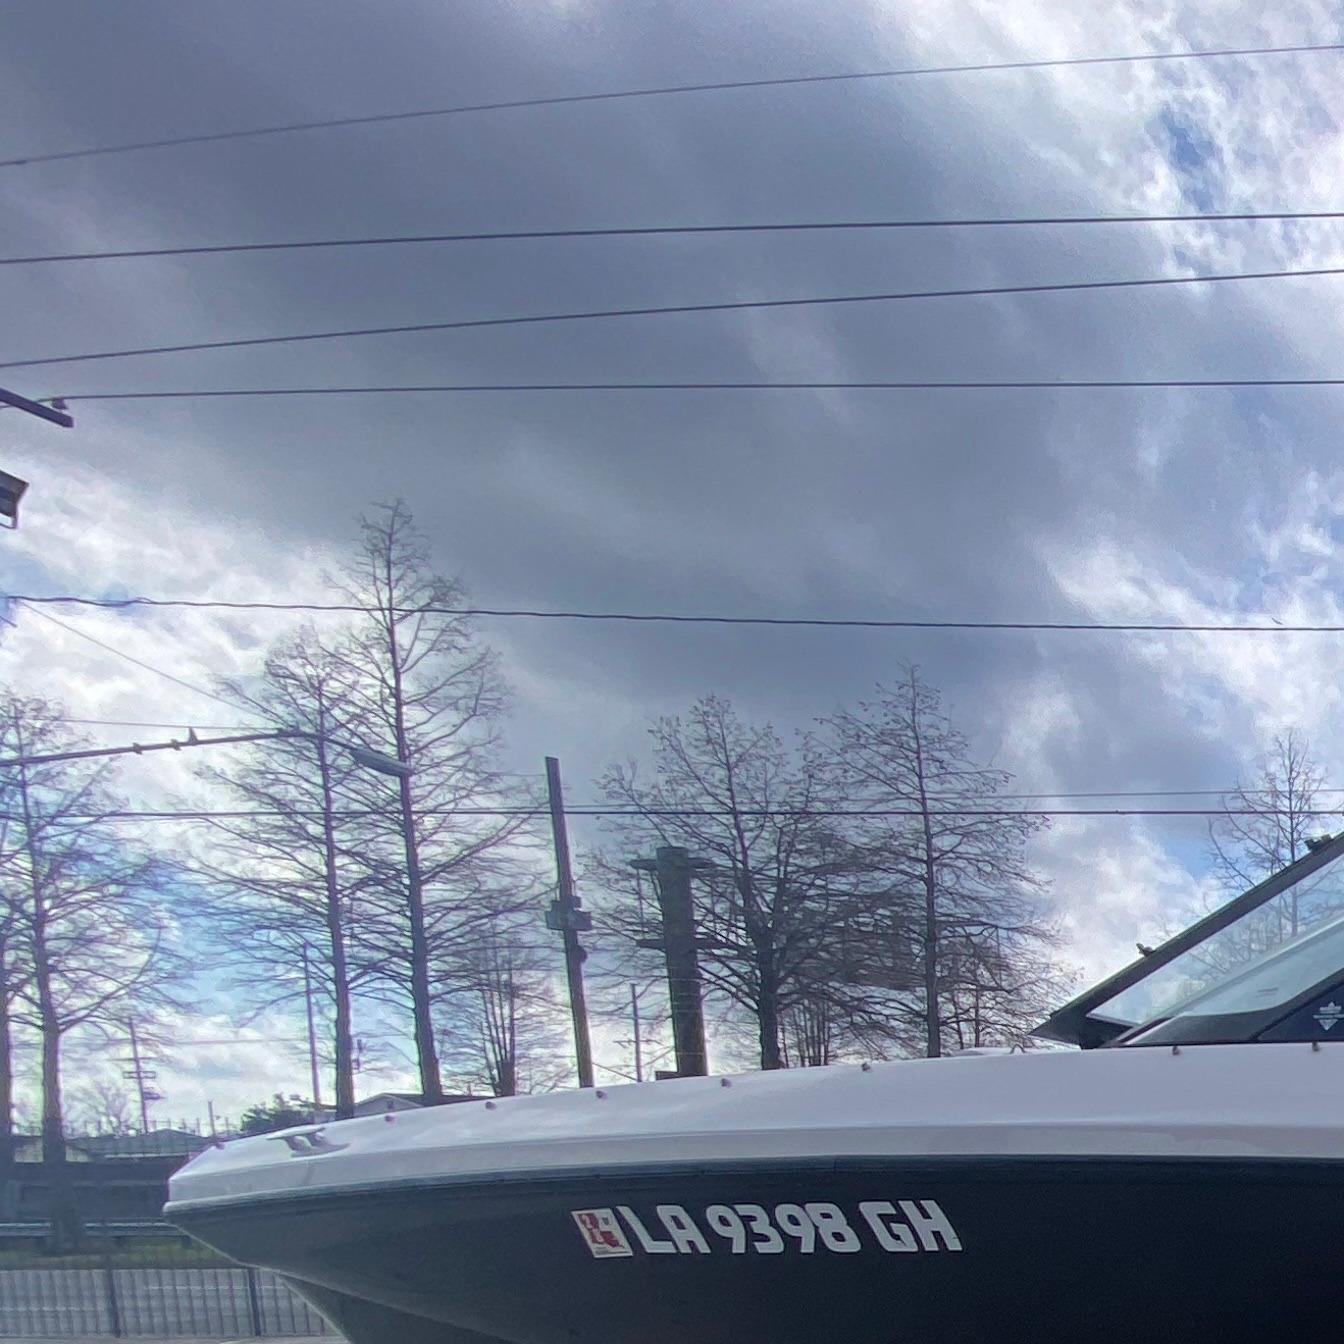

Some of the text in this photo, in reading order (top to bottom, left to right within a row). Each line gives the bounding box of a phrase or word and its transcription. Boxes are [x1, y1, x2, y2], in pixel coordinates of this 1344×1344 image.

[616, 1204, 711, 1254] LA
[705, 1202, 862, 1254] 9398
[859, 1200, 963, 1252] GH
